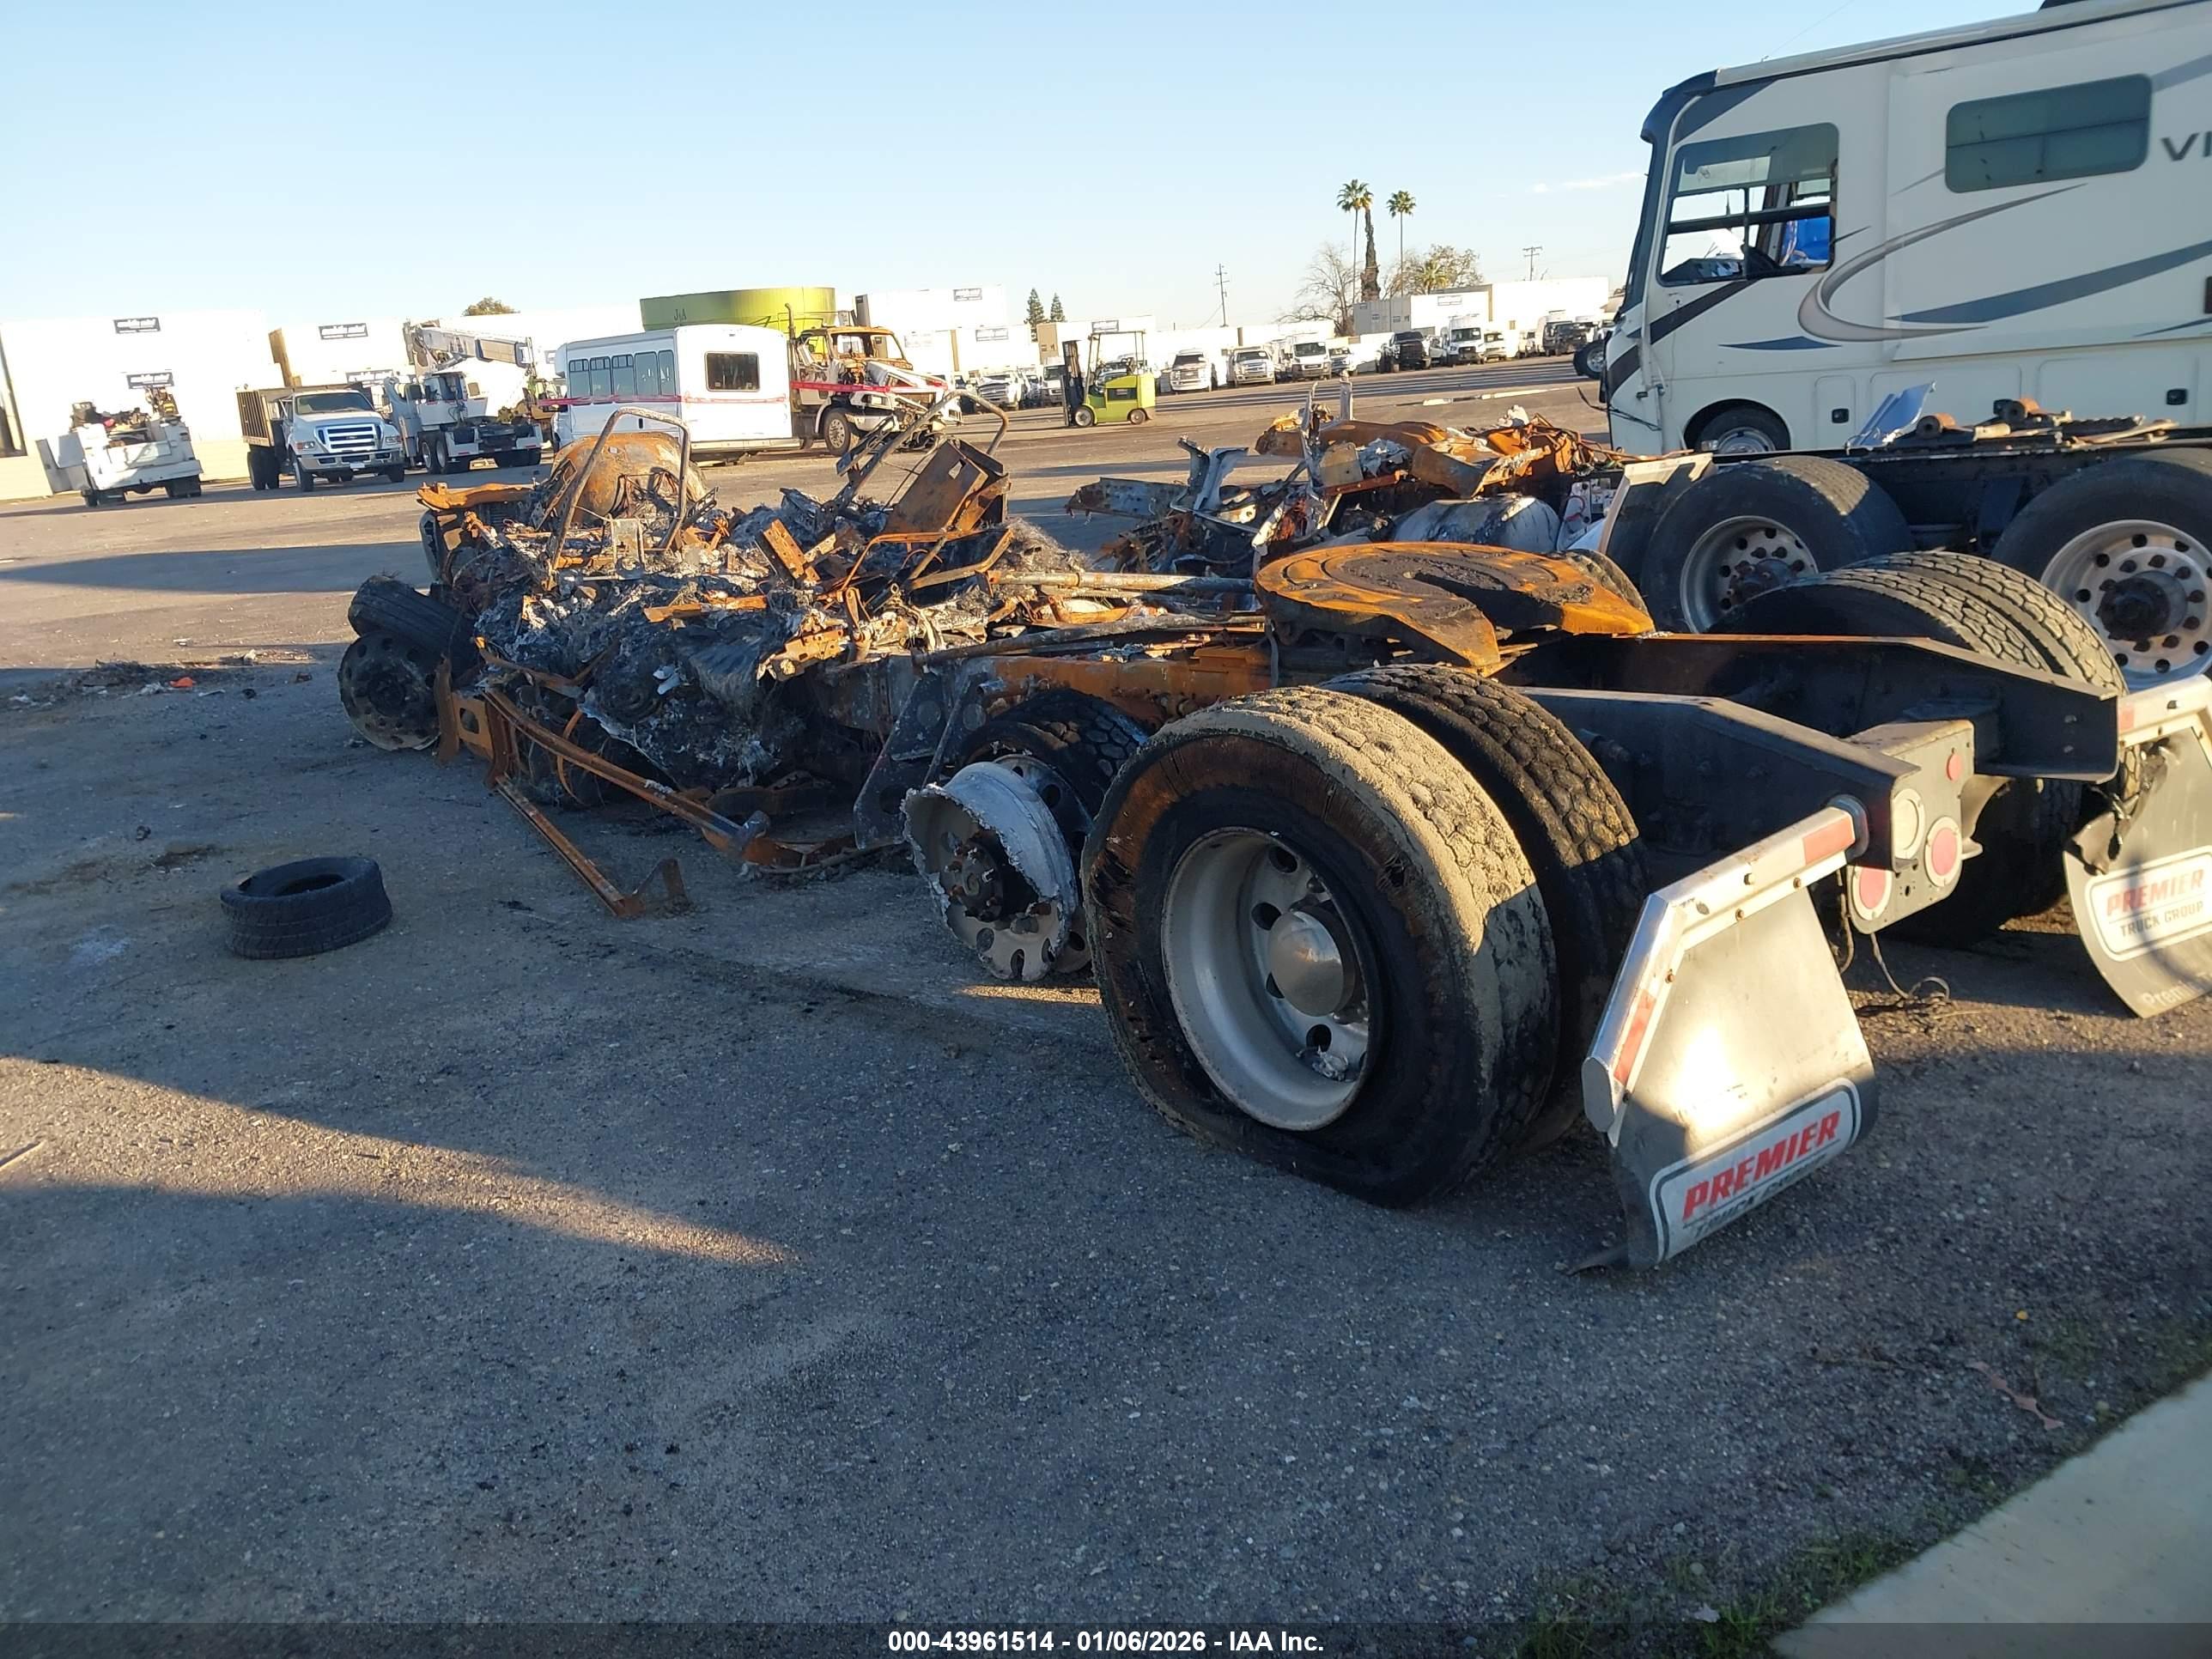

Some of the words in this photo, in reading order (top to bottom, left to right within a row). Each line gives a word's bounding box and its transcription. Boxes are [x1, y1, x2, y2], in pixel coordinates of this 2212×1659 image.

[2106, 869, 2204, 916] PREMIER
[2120, 915, 2160, 937] TRUCK
[2164, 901, 2204, 923] GROUP
[1683, 1111, 1841, 1221] PREMIER
